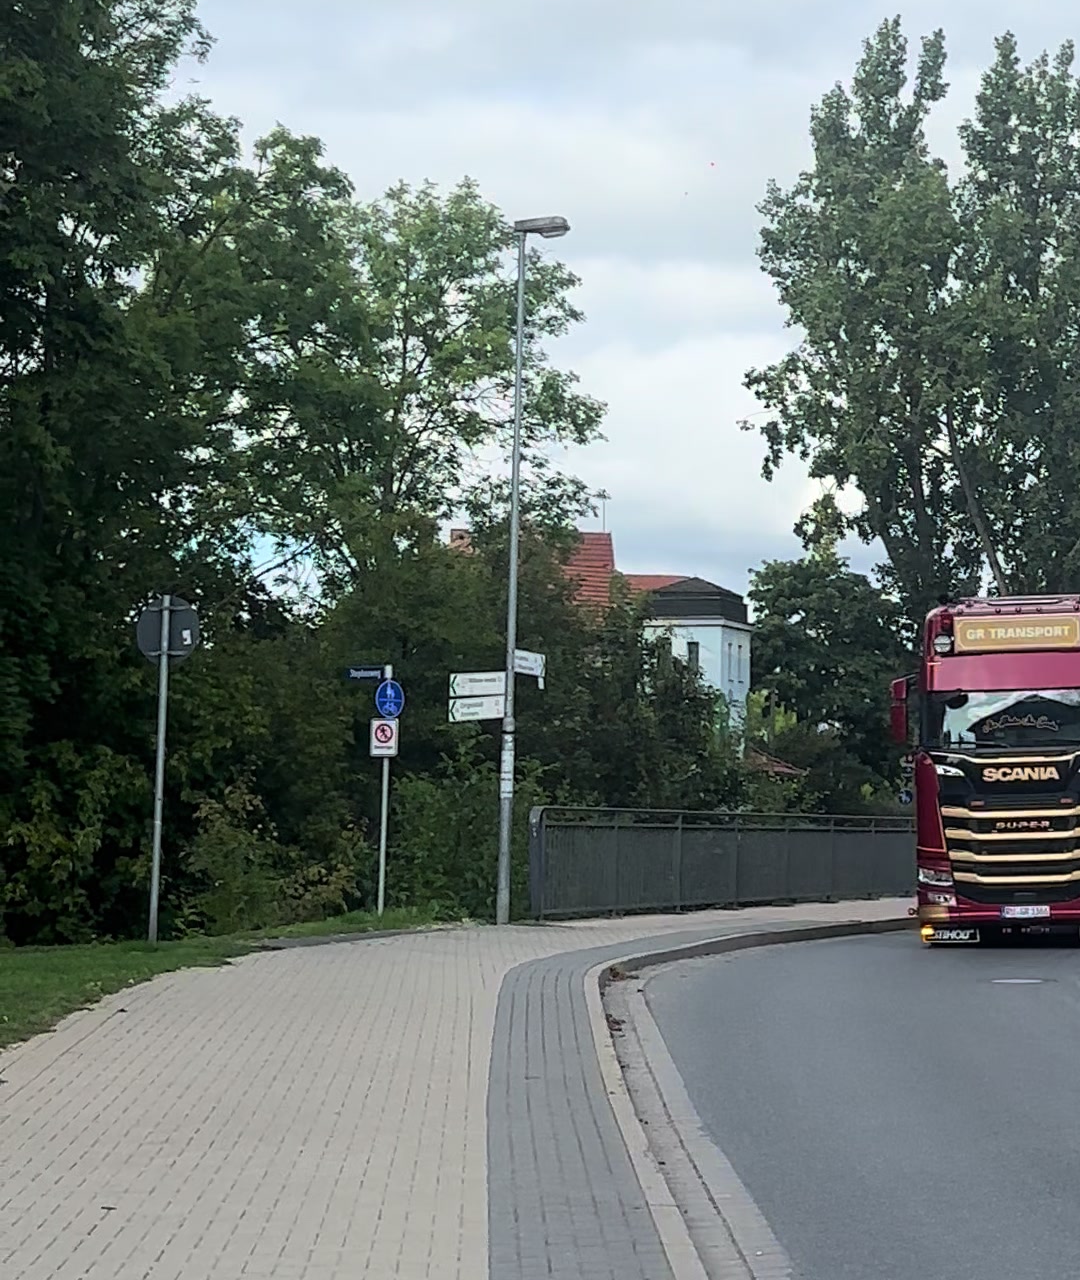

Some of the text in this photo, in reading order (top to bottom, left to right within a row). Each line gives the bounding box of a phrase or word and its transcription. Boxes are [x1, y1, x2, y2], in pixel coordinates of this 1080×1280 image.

[966, 626, 1071, 640] GR TRANSPORT
[982, 766, 1060, 782] SCANIA
[995, 820, 1050, 829] SUPER
